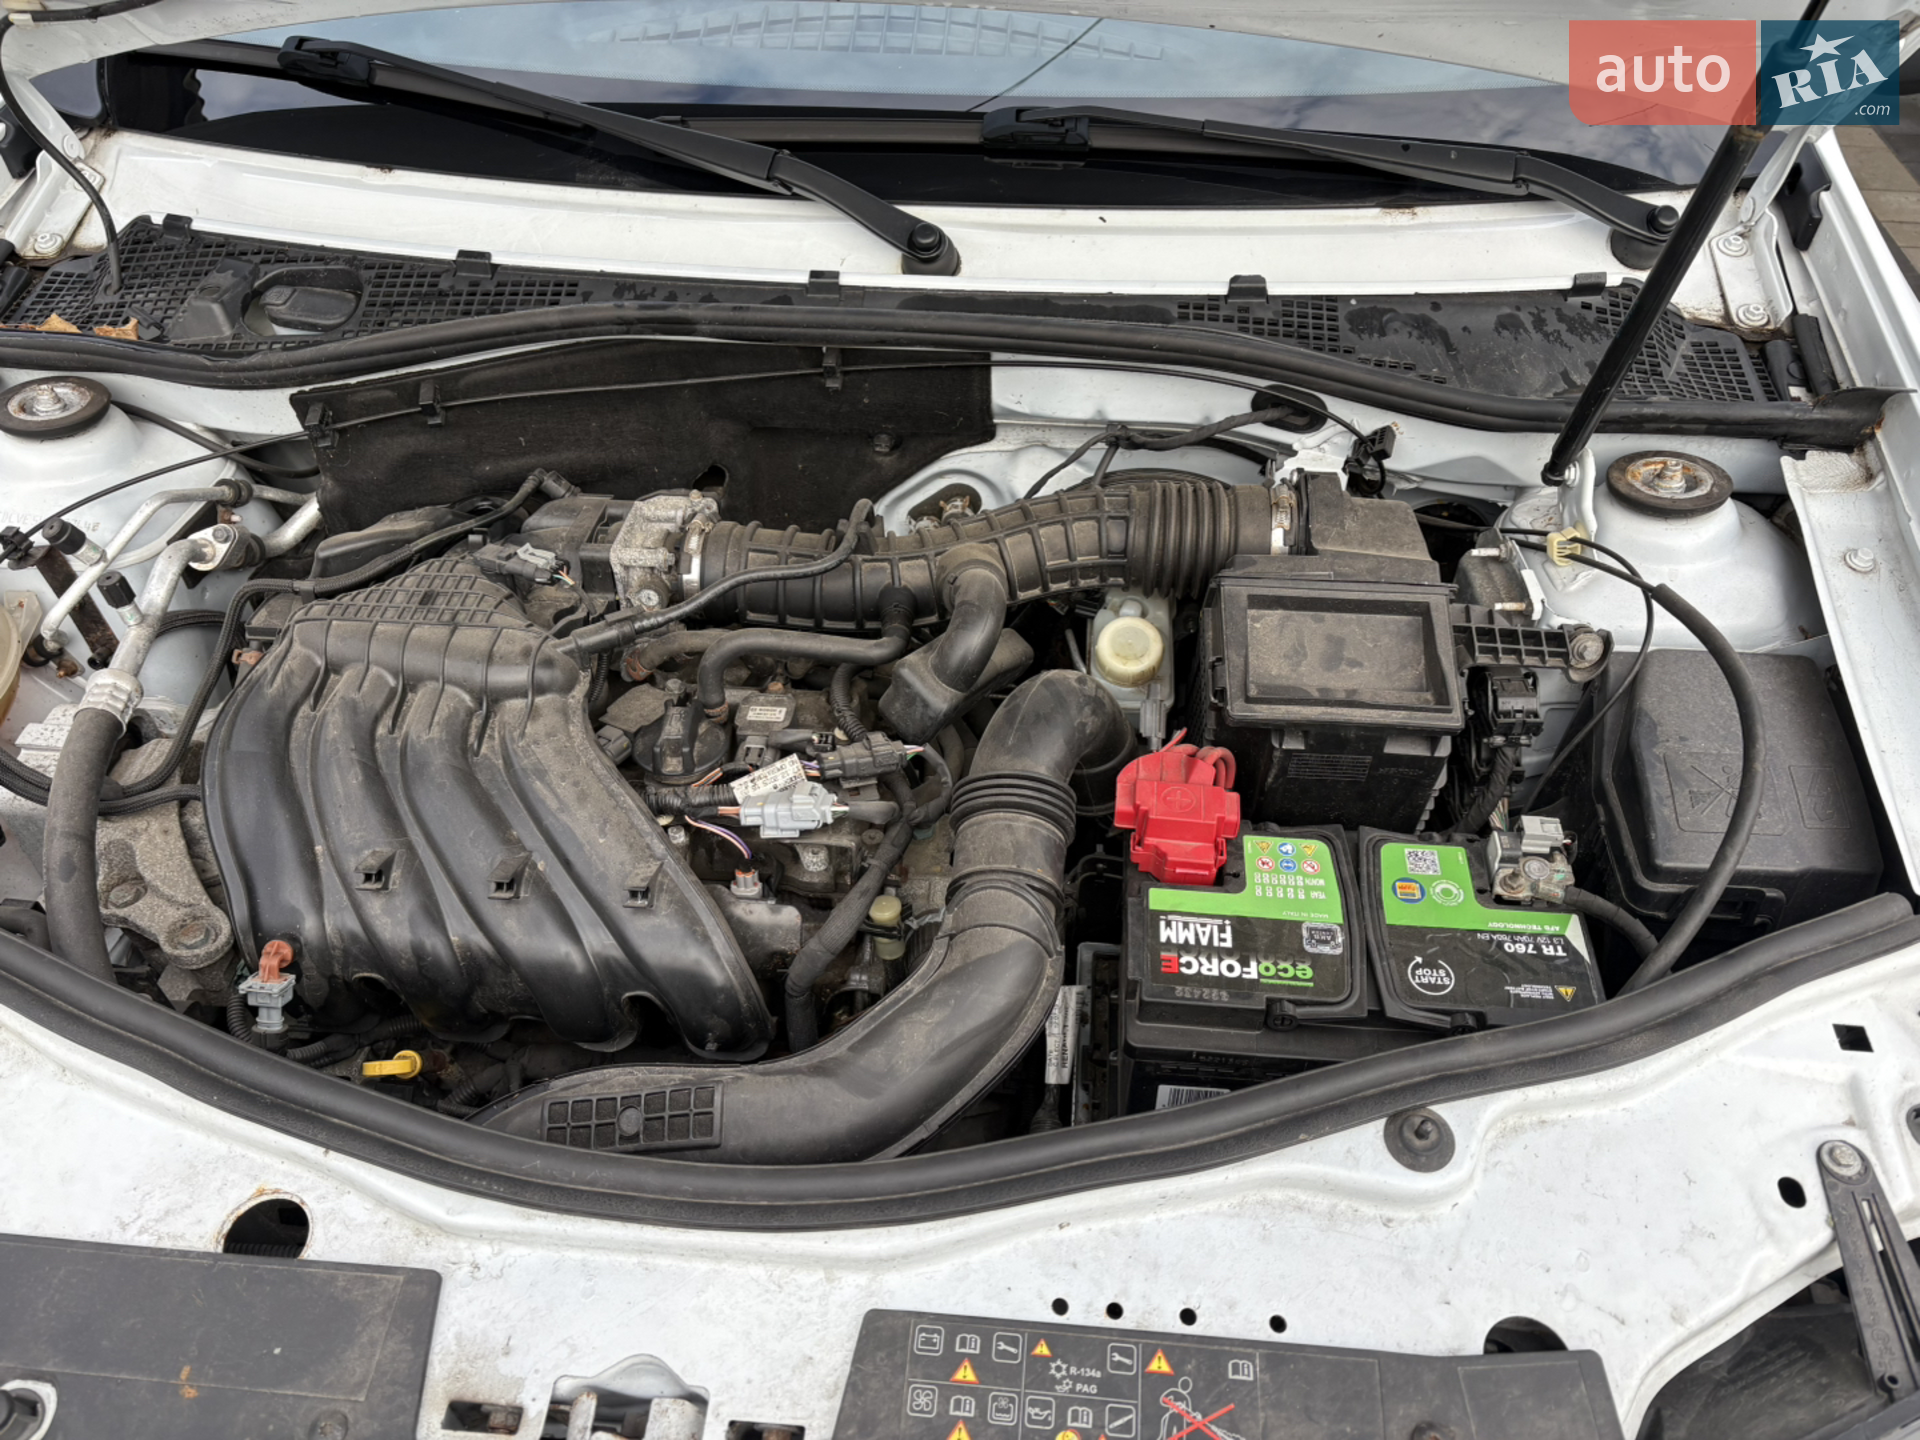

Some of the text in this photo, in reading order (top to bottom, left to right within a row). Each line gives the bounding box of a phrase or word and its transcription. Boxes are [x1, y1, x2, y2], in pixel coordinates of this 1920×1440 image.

[1305, 877, 1326, 886] MONTH
[1310, 891, 1326, 899] YEAR
[1487, 922, 1542, 931] TECHNOLOGY
[1159, 919, 1233, 949] FIAMM
[1476, 932, 1490, 941] EN
[1513, 935, 1534, 943] 70Ah
[1535, 936, 1552, 944] 12V
[1552, 937, 1565, 945] L3
[1503, 942, 1567, 957] TR 760
[1160, 954, 1314, 980] ecoFORCE
[1415, 968, 1447, 978] STOP
[1413, 975, 1451, 985] START
[1069, 1366, 1102, 1378] R-134a
[1075, 1382, 1098, 1394] PAG
